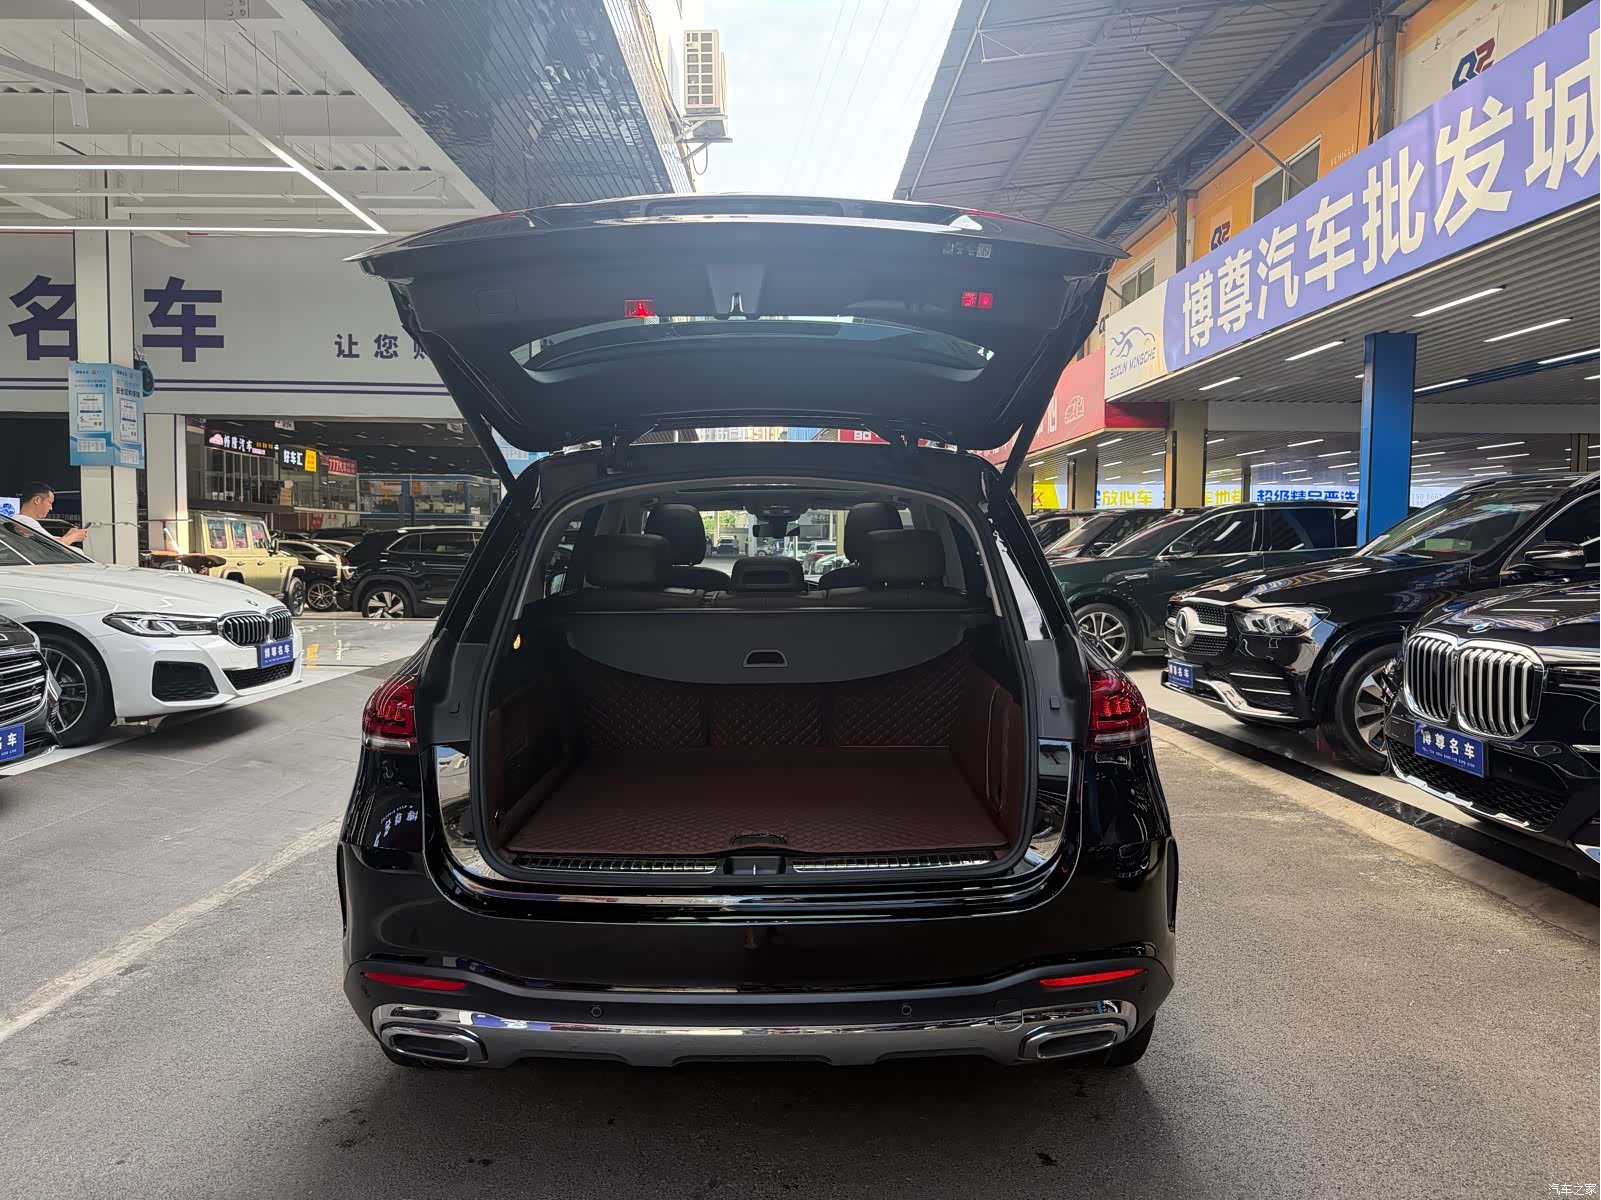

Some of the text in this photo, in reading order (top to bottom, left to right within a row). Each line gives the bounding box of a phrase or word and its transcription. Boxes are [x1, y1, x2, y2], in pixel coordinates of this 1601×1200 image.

[1257, 489, 1359, 501] 超级精品严选
[0, 732, 17, 749] 车
